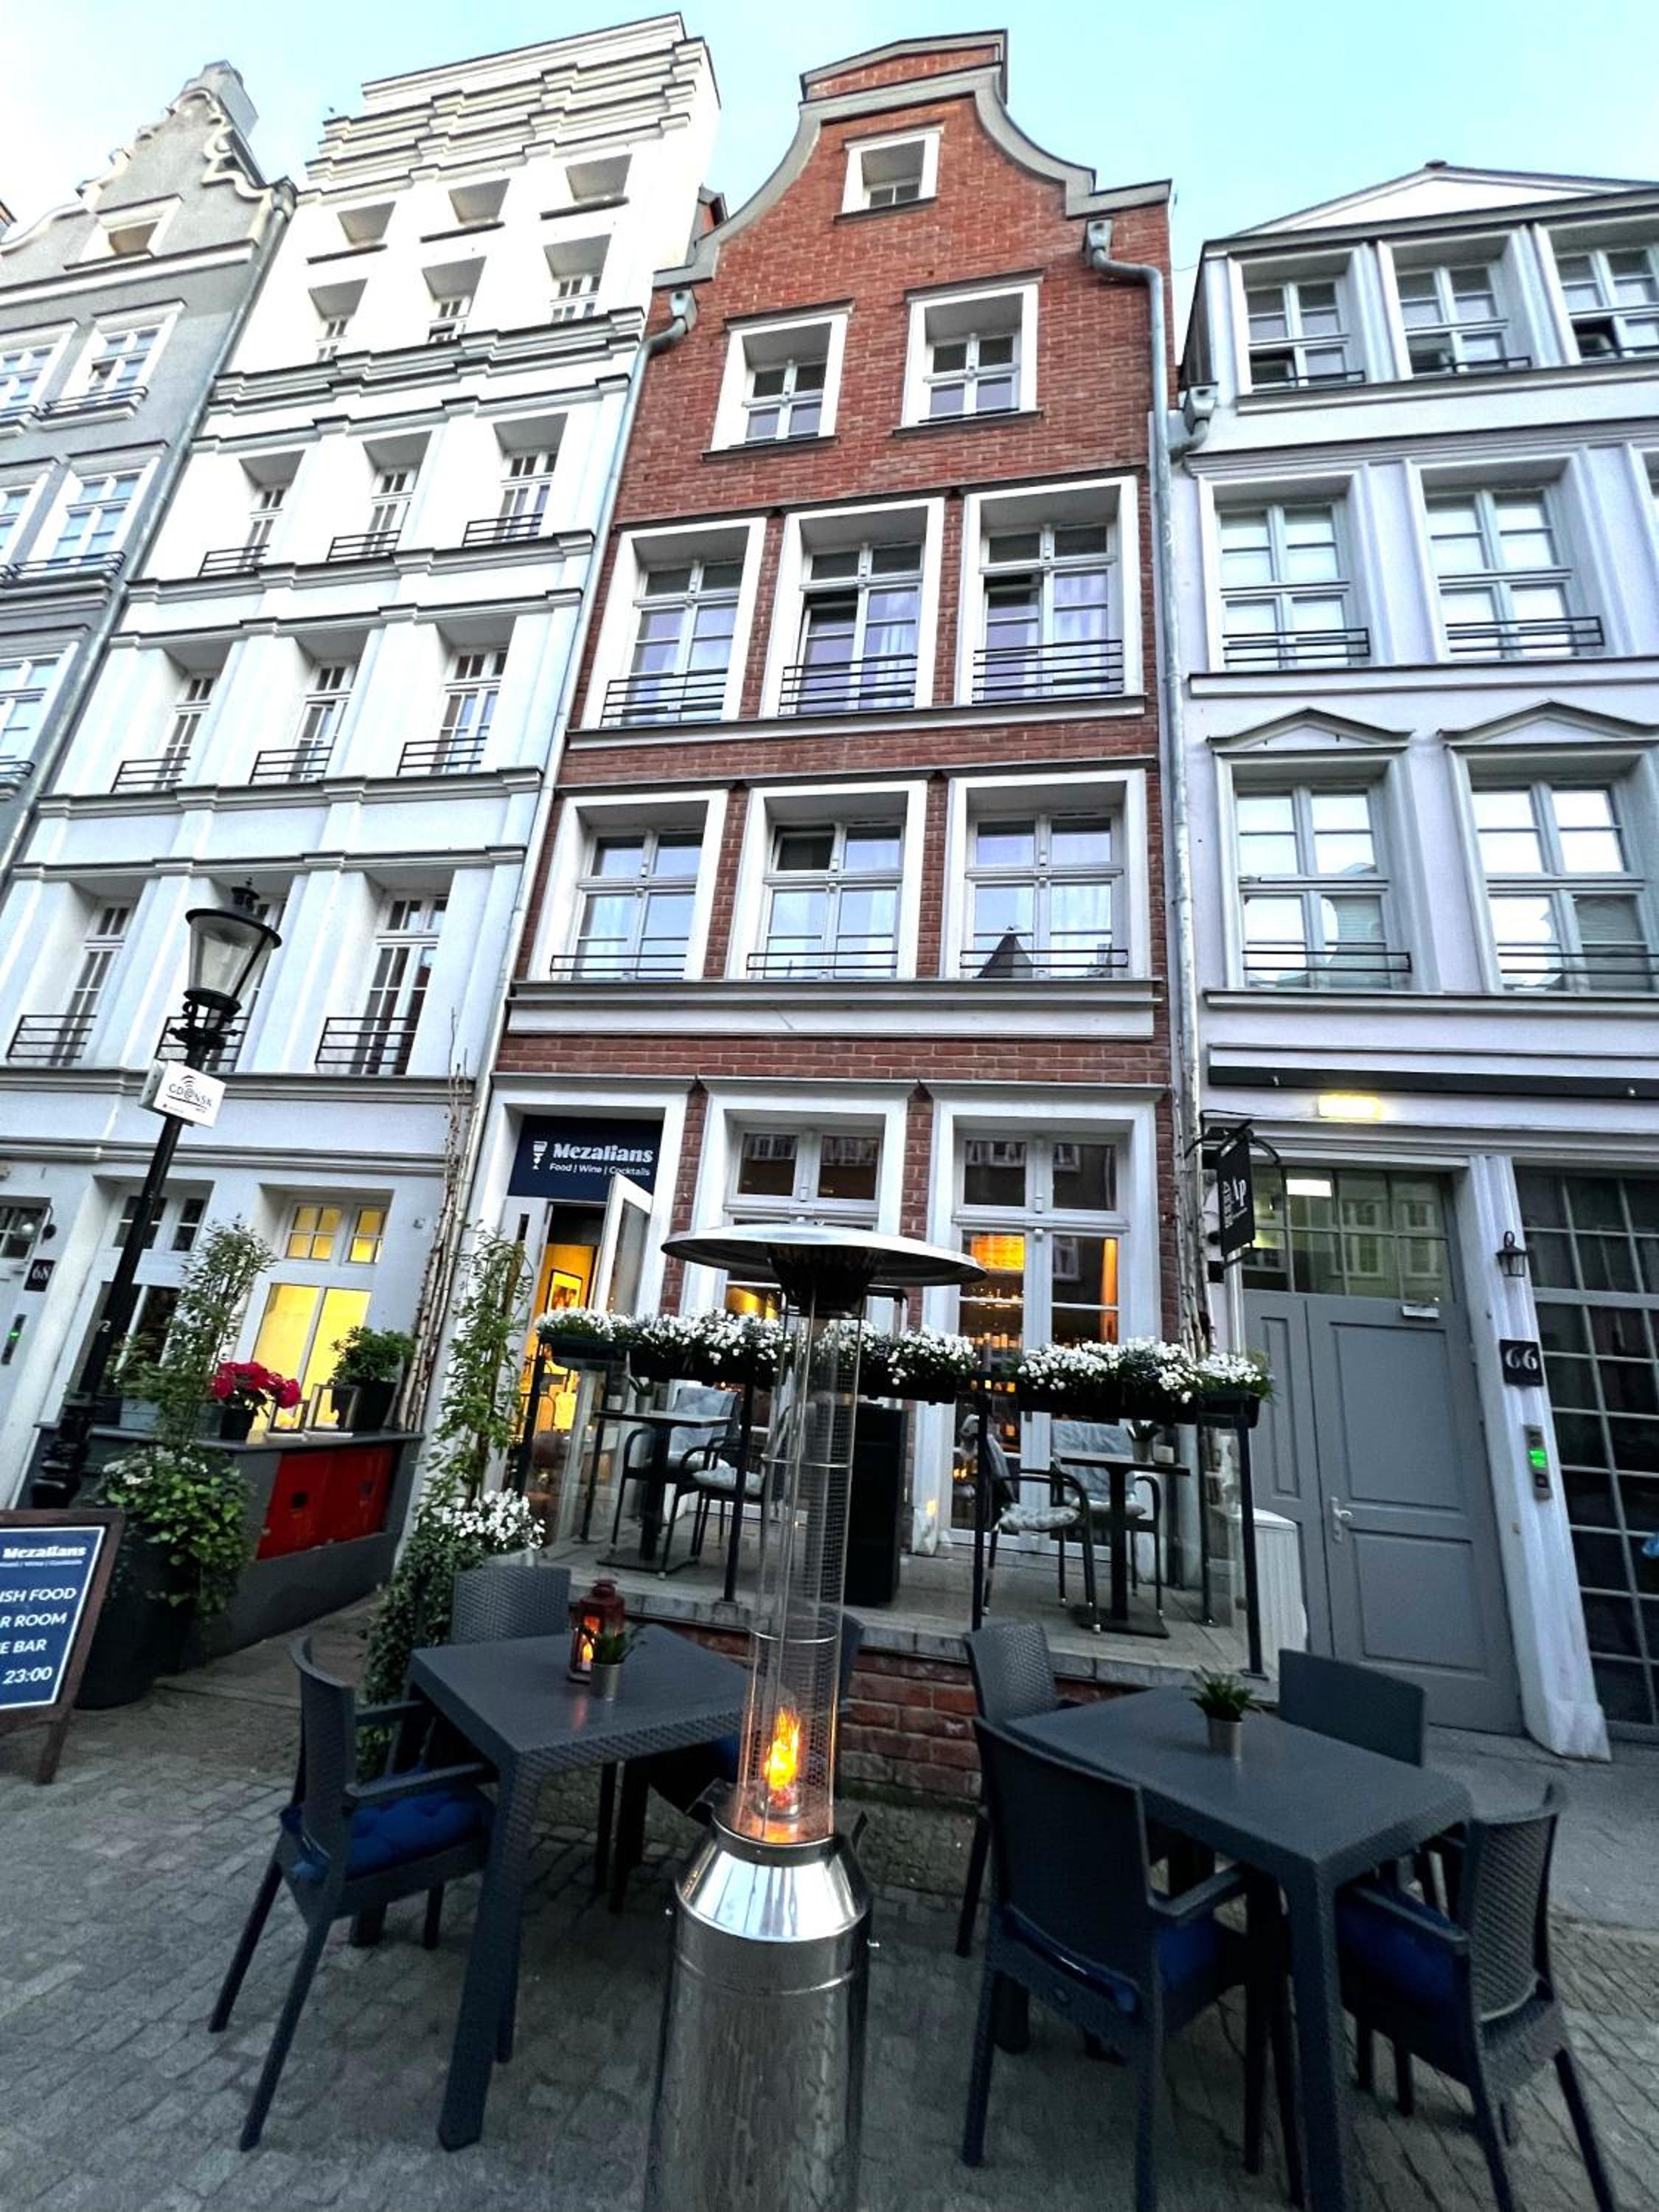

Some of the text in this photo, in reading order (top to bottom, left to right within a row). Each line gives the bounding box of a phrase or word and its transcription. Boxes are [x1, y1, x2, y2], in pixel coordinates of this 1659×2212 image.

[553, 1143, 654, 1163] Mezalians
[549, 1163, 573, 1172] Food
[579, 1164, 603, 1174] Wine
[1506, 1346, 1538, 1371] 66
[29, 1587, 77, 1601] FOOD
[14, 1612, 67, 1627] ROOM
[13, 1638, 47, 1653] BAR
[2, 1666, 53, 1685] 23:00
